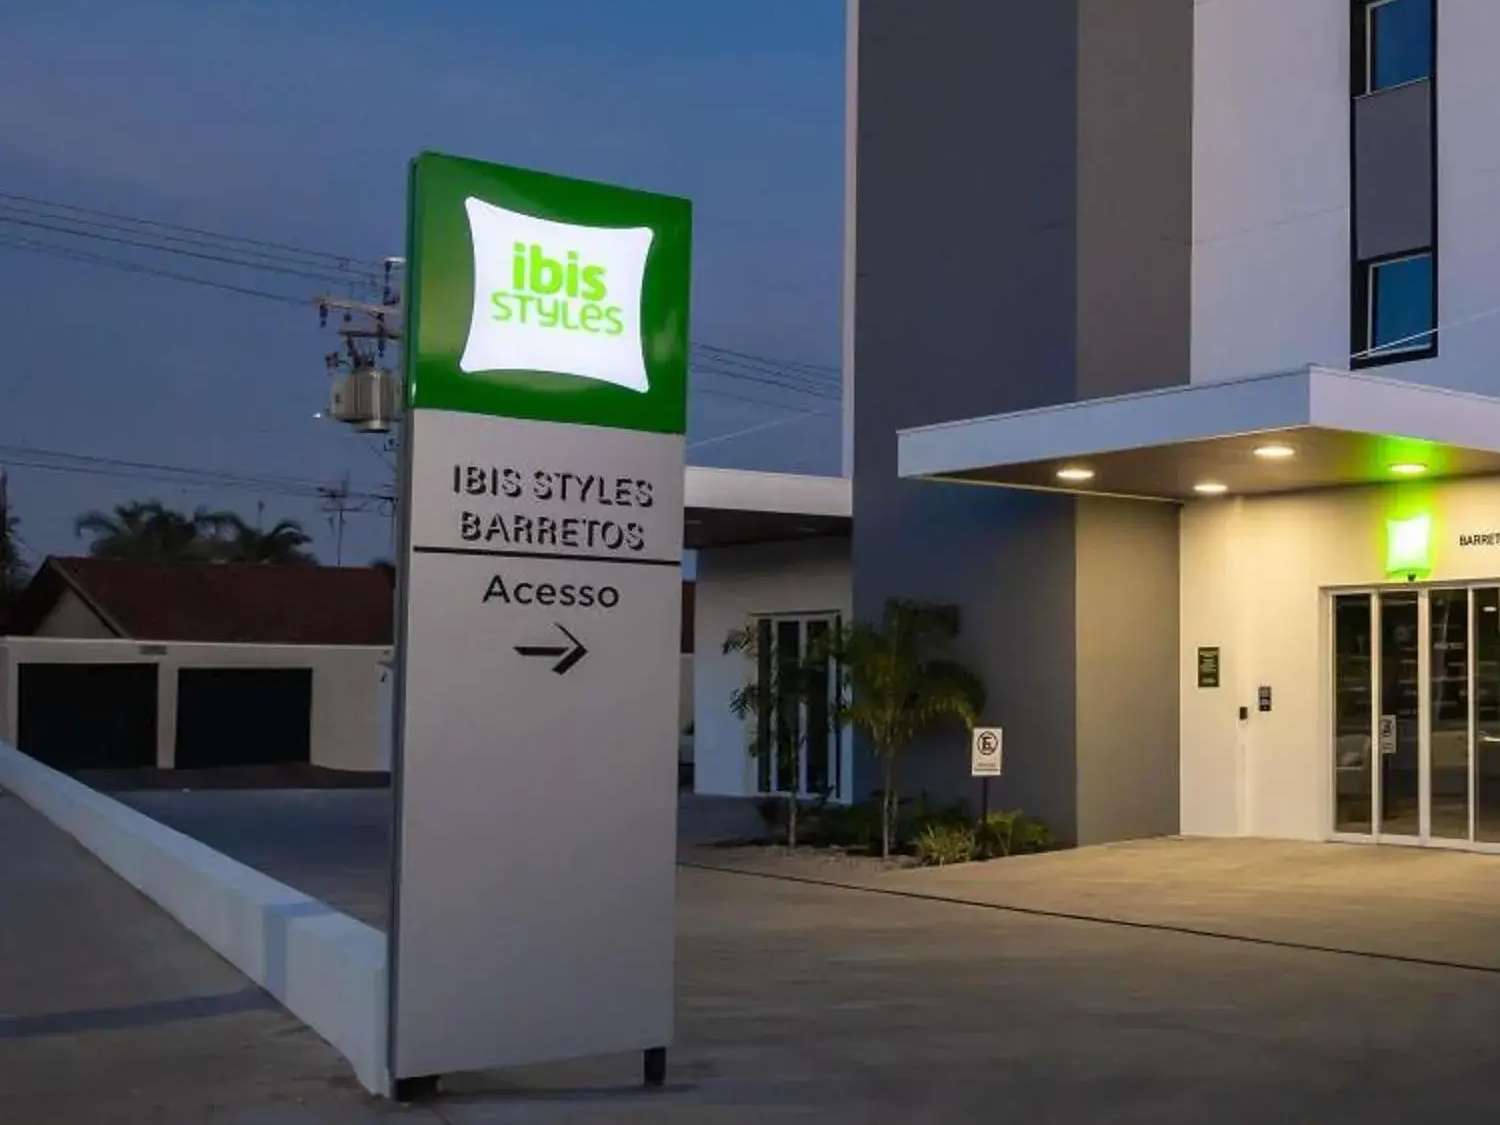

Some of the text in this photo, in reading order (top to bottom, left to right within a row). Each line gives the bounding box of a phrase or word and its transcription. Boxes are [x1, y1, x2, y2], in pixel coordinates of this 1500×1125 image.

[513, 241, 607, 301] ibis
[453, 464, 654, 507] IBIS STYLES
[461, 511, 645, 551] BARRETOS
[482, 574, 620, 608] Acesso
